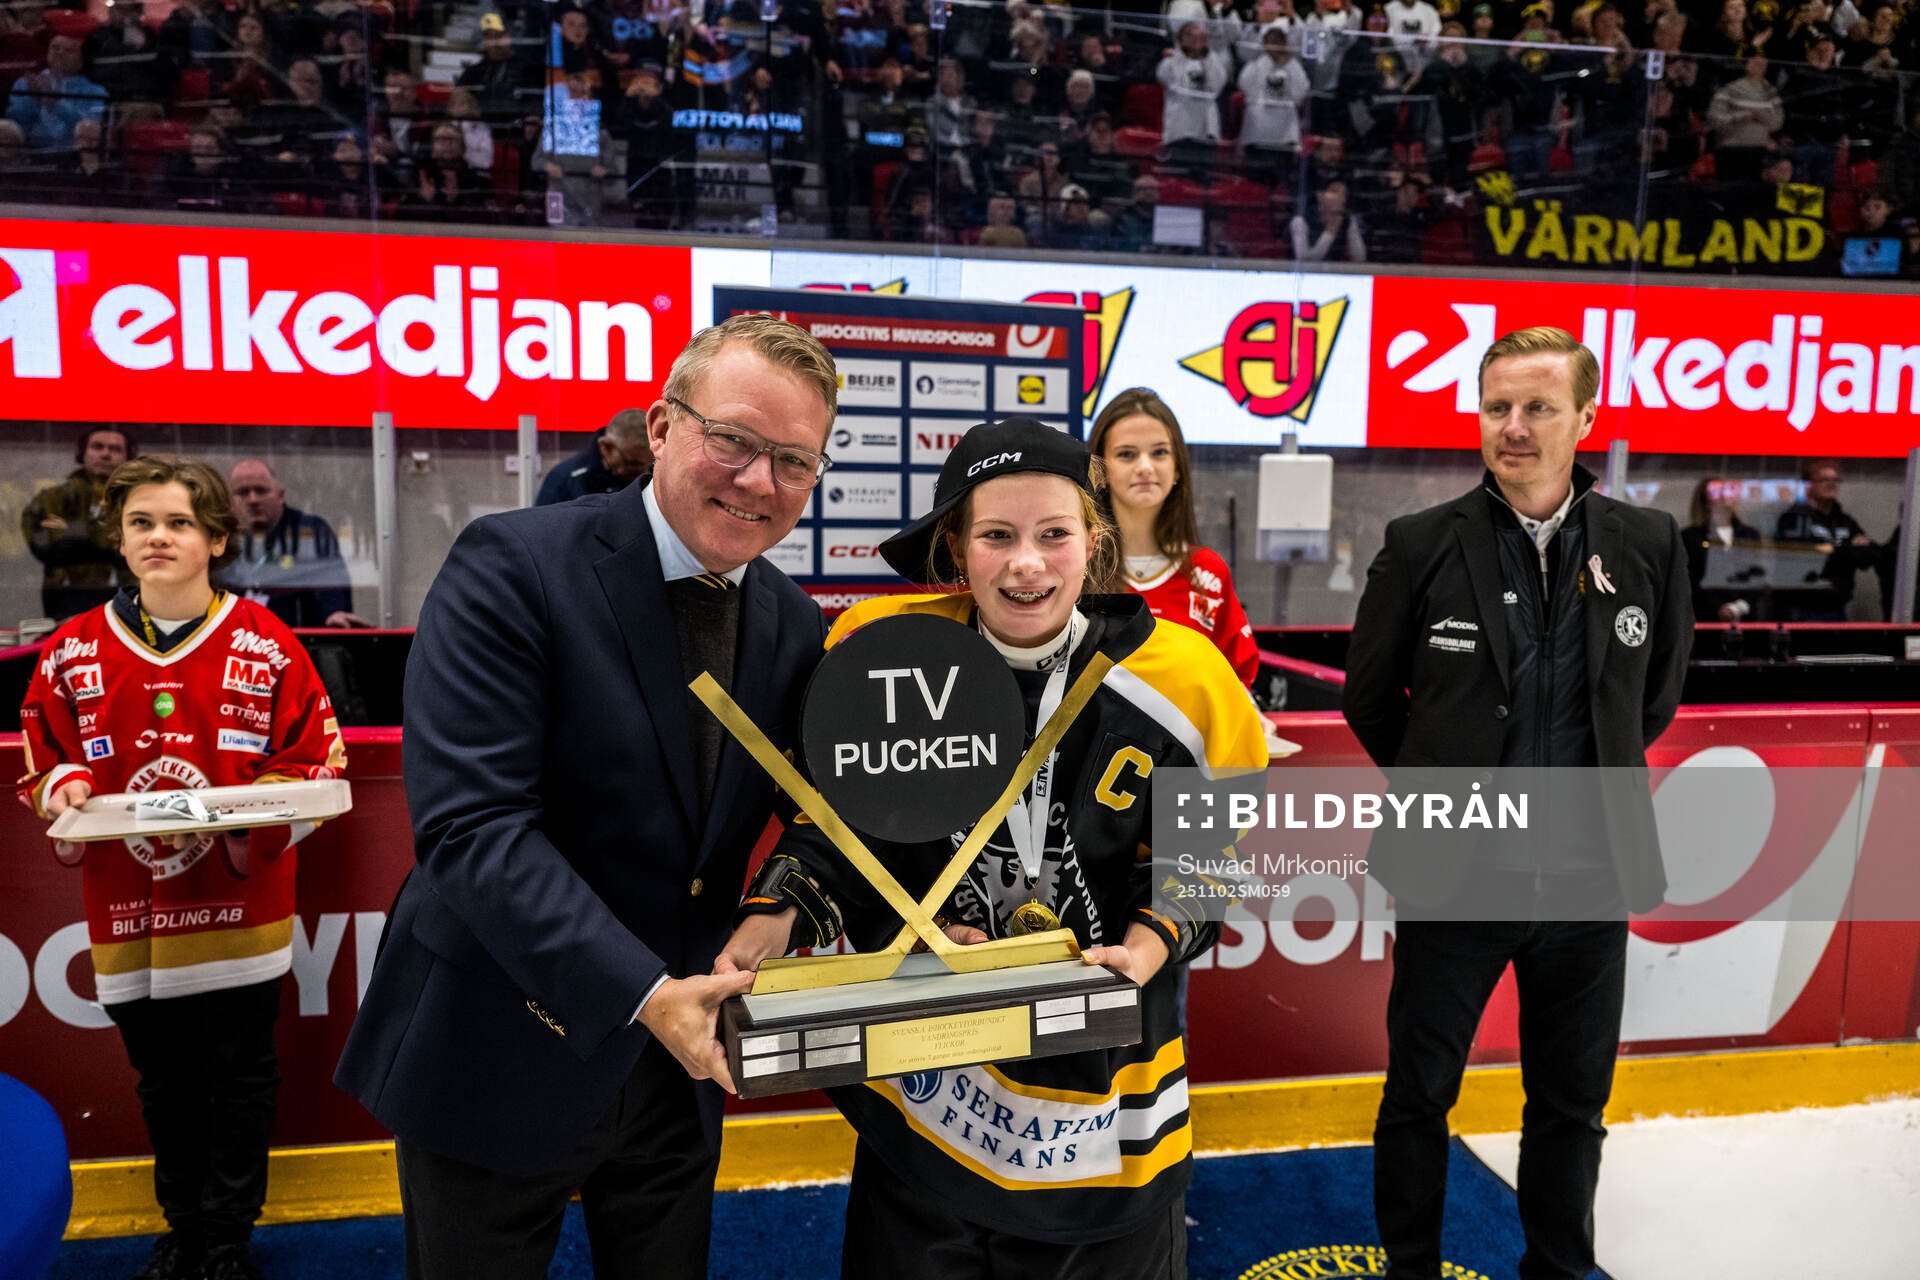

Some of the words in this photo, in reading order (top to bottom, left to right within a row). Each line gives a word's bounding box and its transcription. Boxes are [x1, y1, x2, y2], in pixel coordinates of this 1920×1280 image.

[1486, 200, 1825, 268] VÄRMLAND
[91, 255, 652, 401] elkedjan
[892, 328, 995, 347] HUVUDSPONSOR
[848, 374, 896, 387] BEIJER
[1582, 308, 1920, 432] lkedjan
[967, 452, 1022, 478] CCM
[867, 665, 960, 724] TV
[834, 733, 997, 777] PUCKEN
[1094, 744, 1154, 812] C
[215, 908, 244, 923] AB
[940, 1105, 1077, 1169] FINANS
[951, 1073, 1119, 1142] SERAFIM
